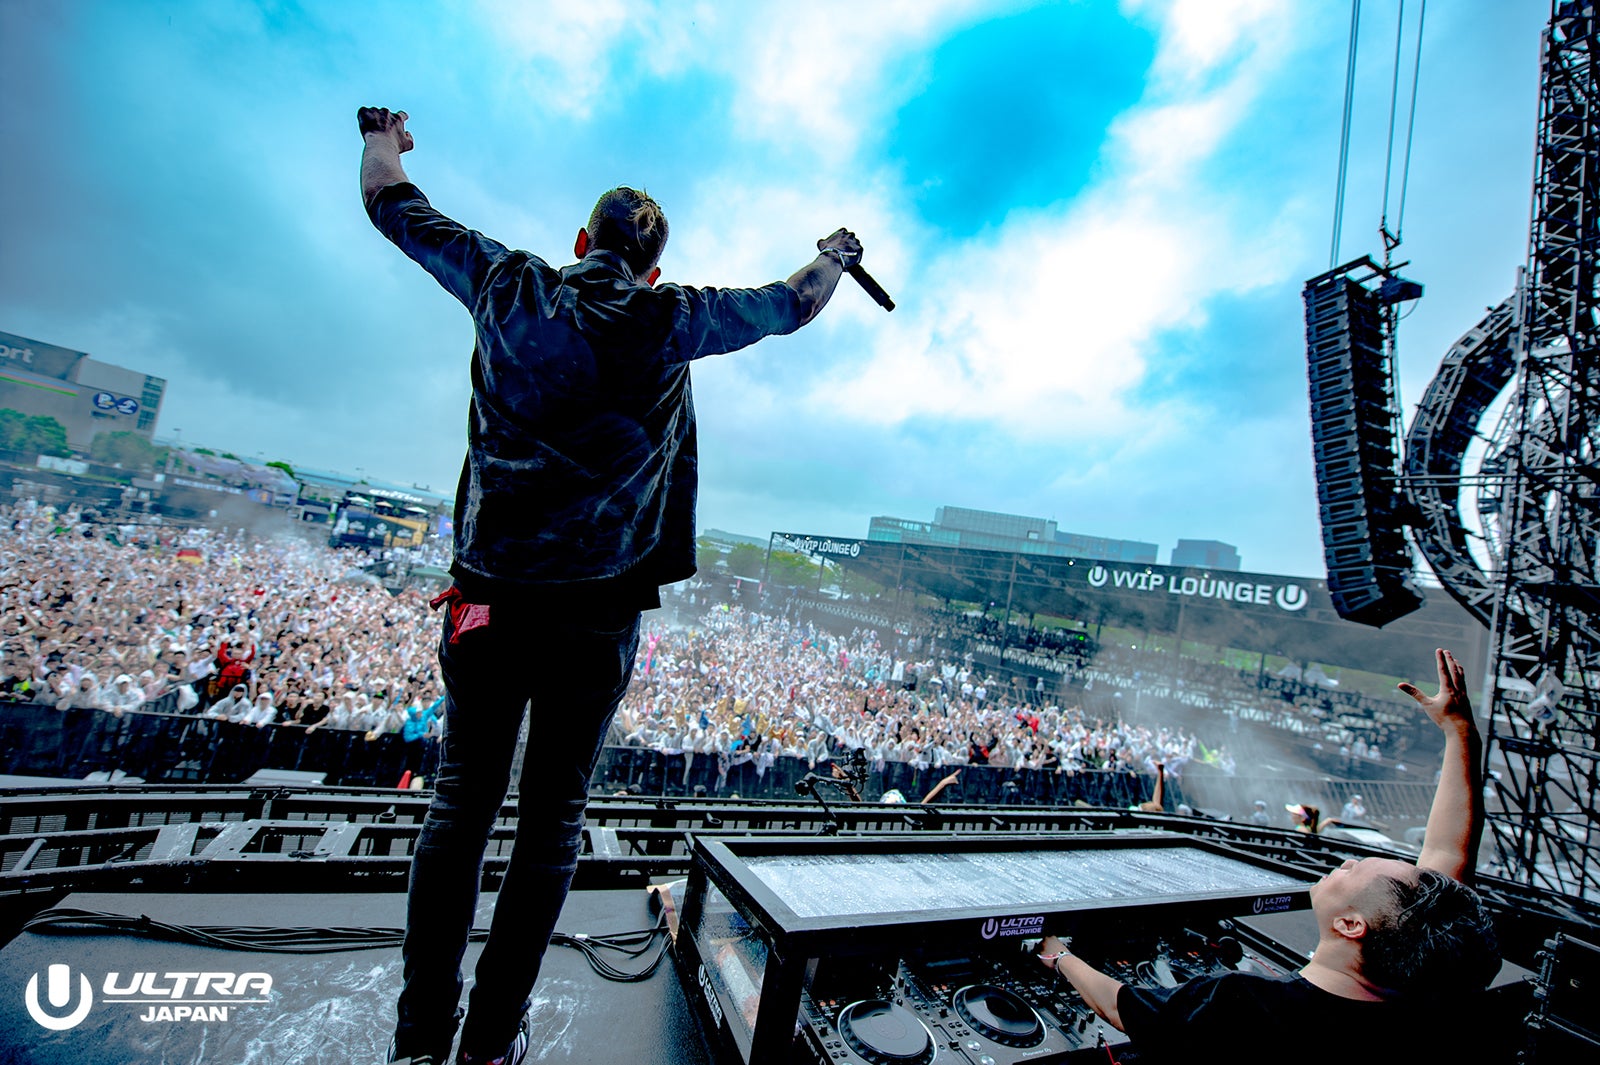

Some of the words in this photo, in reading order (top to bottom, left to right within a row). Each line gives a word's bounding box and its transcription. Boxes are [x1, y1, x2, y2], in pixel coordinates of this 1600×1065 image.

[819, 541, 851, 555] LOUNGE
[1112, 570, 1165, 592] VVIP
[1168, 575, 1273, 605] LOUNGE
[1001, 916, 1045, 928] ULTRA
[1000, 927, 1042, 937] WORLDWIDE
